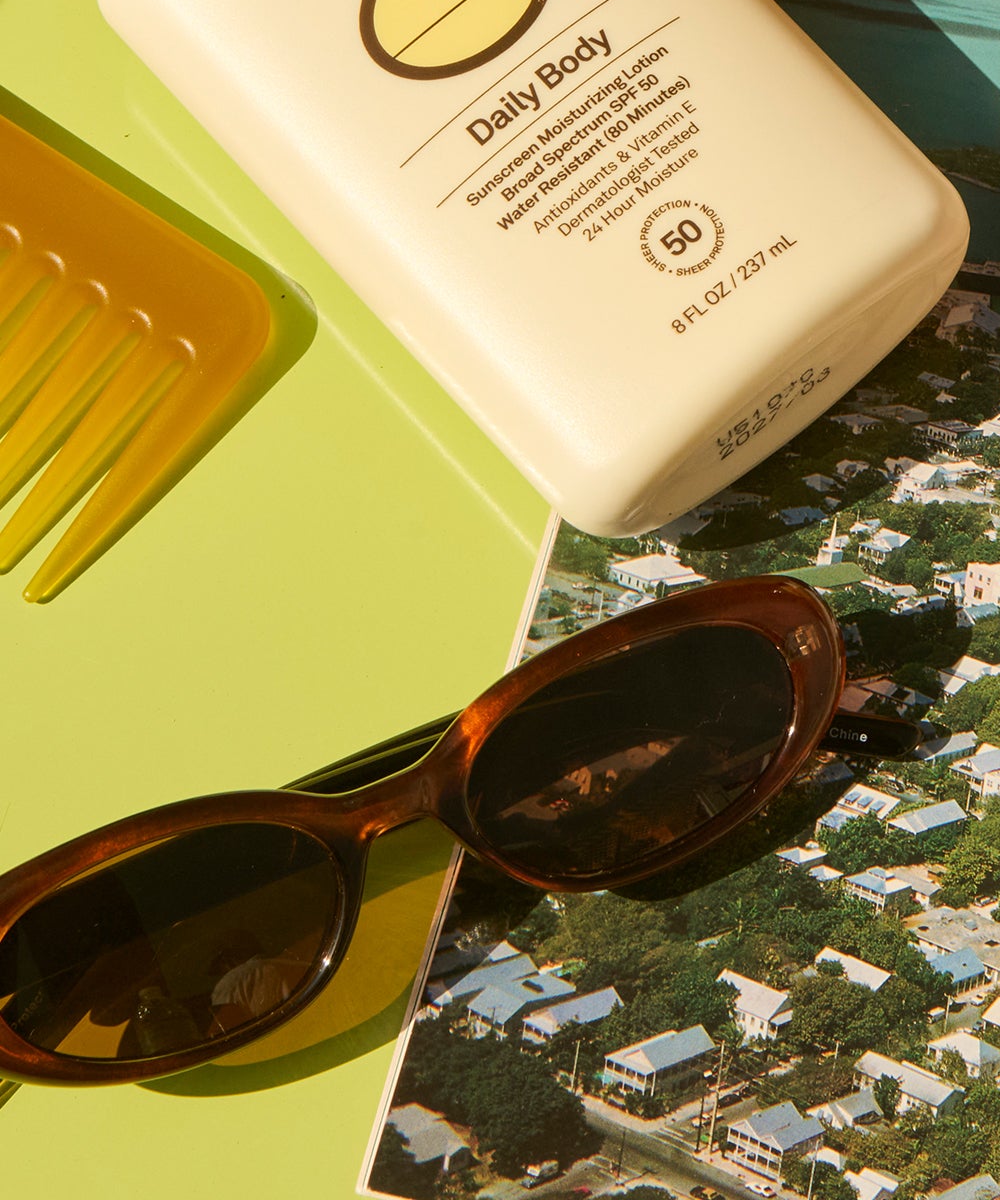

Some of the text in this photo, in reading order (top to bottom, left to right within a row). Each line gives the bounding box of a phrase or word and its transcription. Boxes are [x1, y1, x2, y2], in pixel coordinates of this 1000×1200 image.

[465, 29, 611, 146] Daily Body
[466, 47, 669, 206] Sunscreen Moisturizing Lotion
[501, 74, 659, 202] Broad Spectrum SPF 50
[497, 76, 690, 230] Water Resistant (80 Minutes)
[534, 100, 696, 234] Antioxidants & Vitamin E
[557, 121, 699, 236] Dermatologist Tested
[583, 149, 698, 241] 24 Hour Moisture
[640, 200, 691, 272] SHEER PROTECTION
[660, 219, 702, 256] 50
[672, 319, 686, 334] 8
[682, 304, 709, 324] FL
[705, 281, 731, 305] OZ
[737, 251, 766, 280] 237
[769, 235, 797, 257] mL
[676, 204, 725, 276] SHEER PROTECTION
